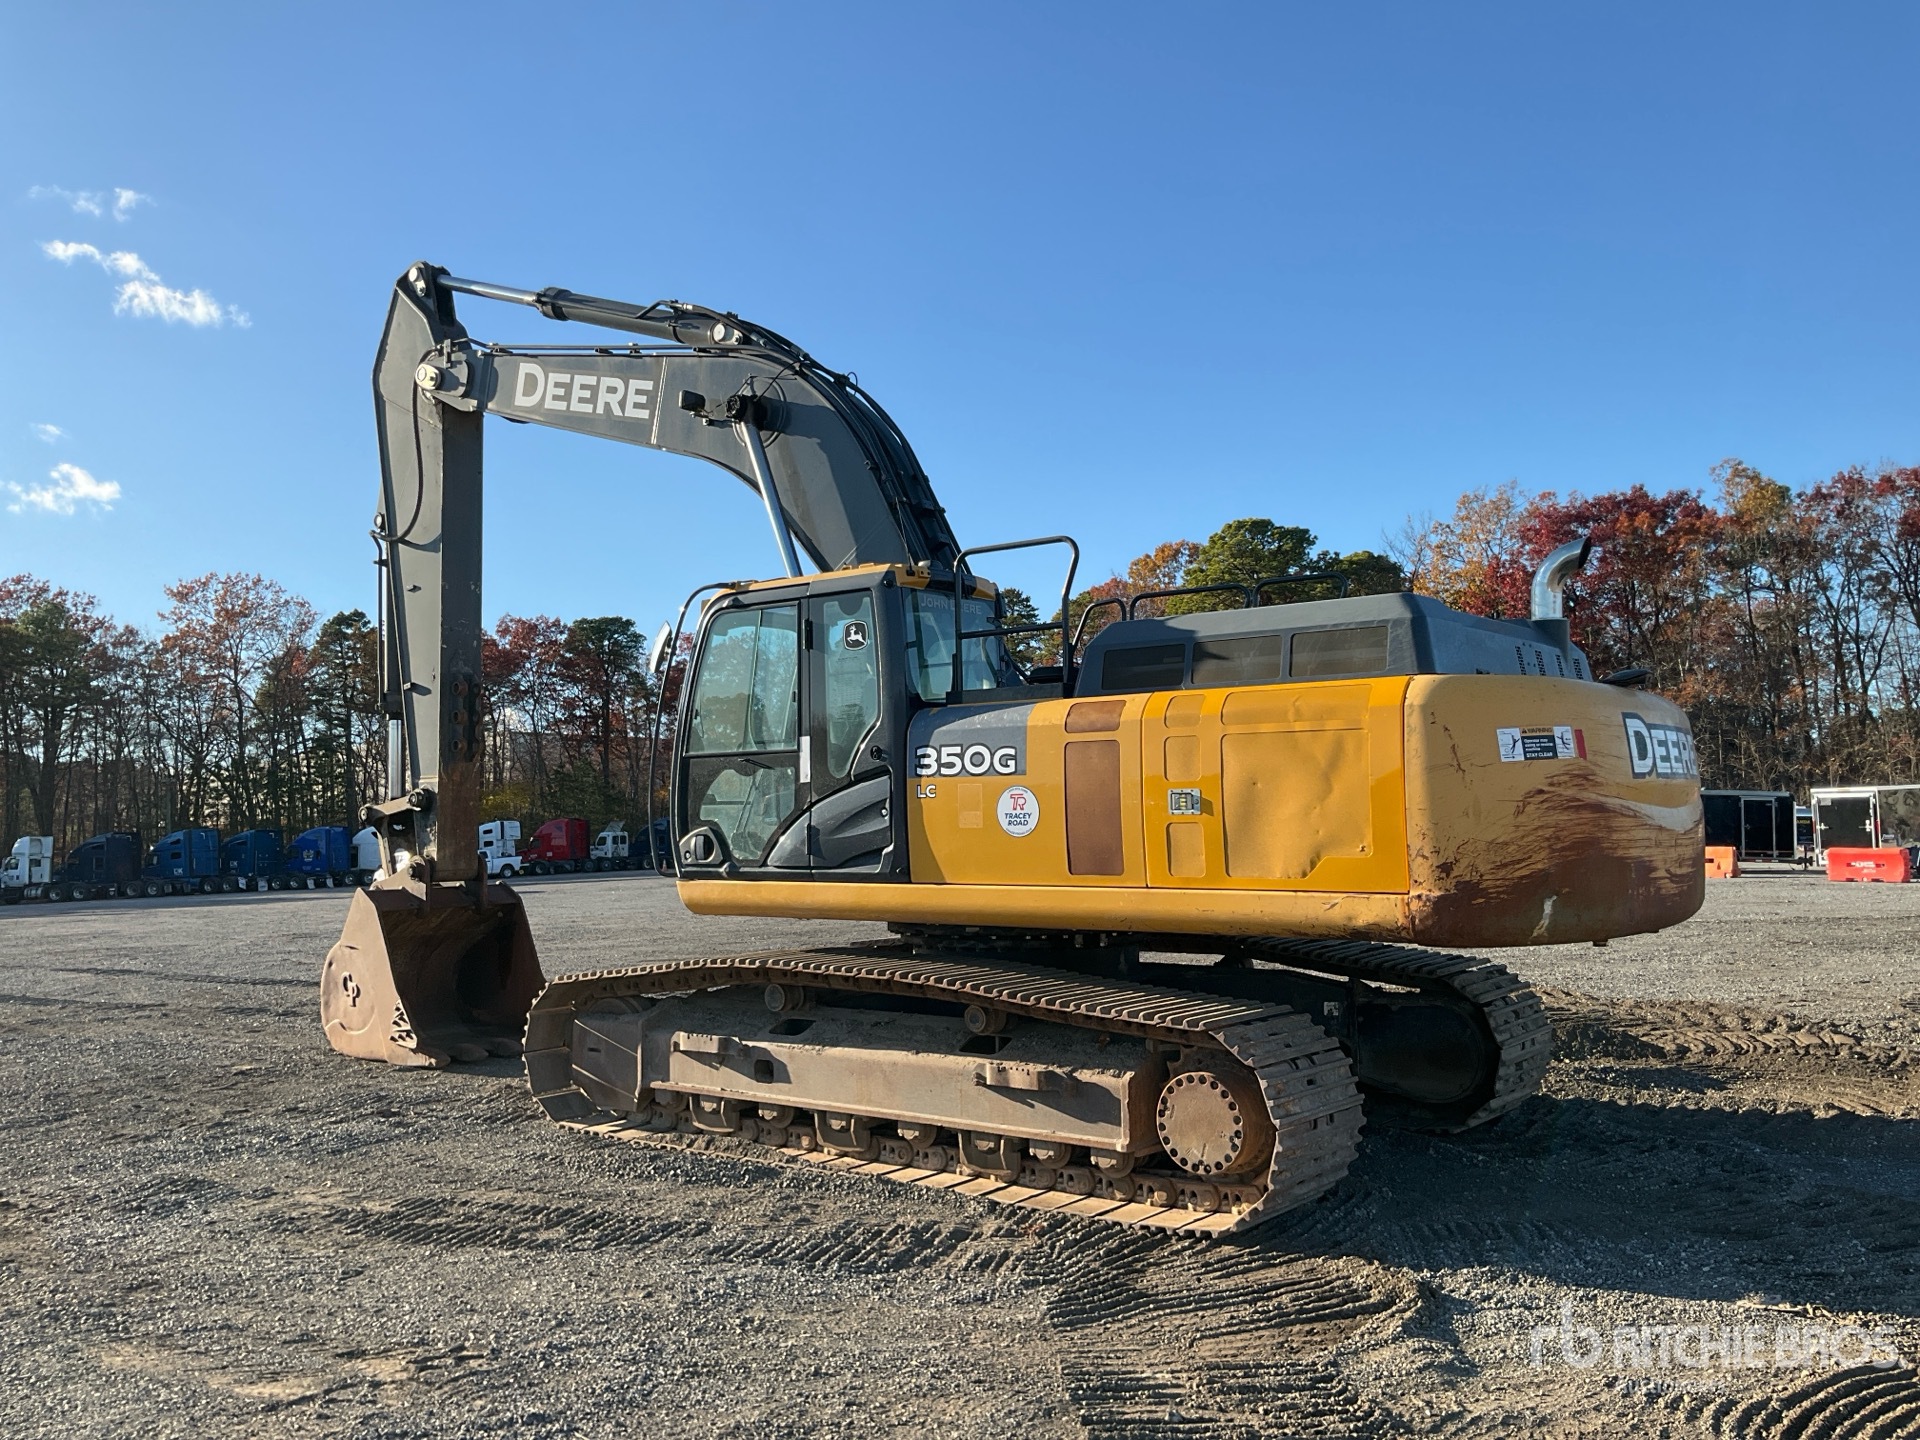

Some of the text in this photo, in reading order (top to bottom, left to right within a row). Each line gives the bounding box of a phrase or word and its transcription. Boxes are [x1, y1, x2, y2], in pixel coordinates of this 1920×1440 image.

[514, 362, 654, 419] DEERE
[921, 596, 982, 614] JOHN DERE
[1622, 713, 1698, 778] DEERE
[915, 743, 1017, 776] 350G
[916, 785, 937, 798] LC
[1008, 819, 1029, 827] ROAD
